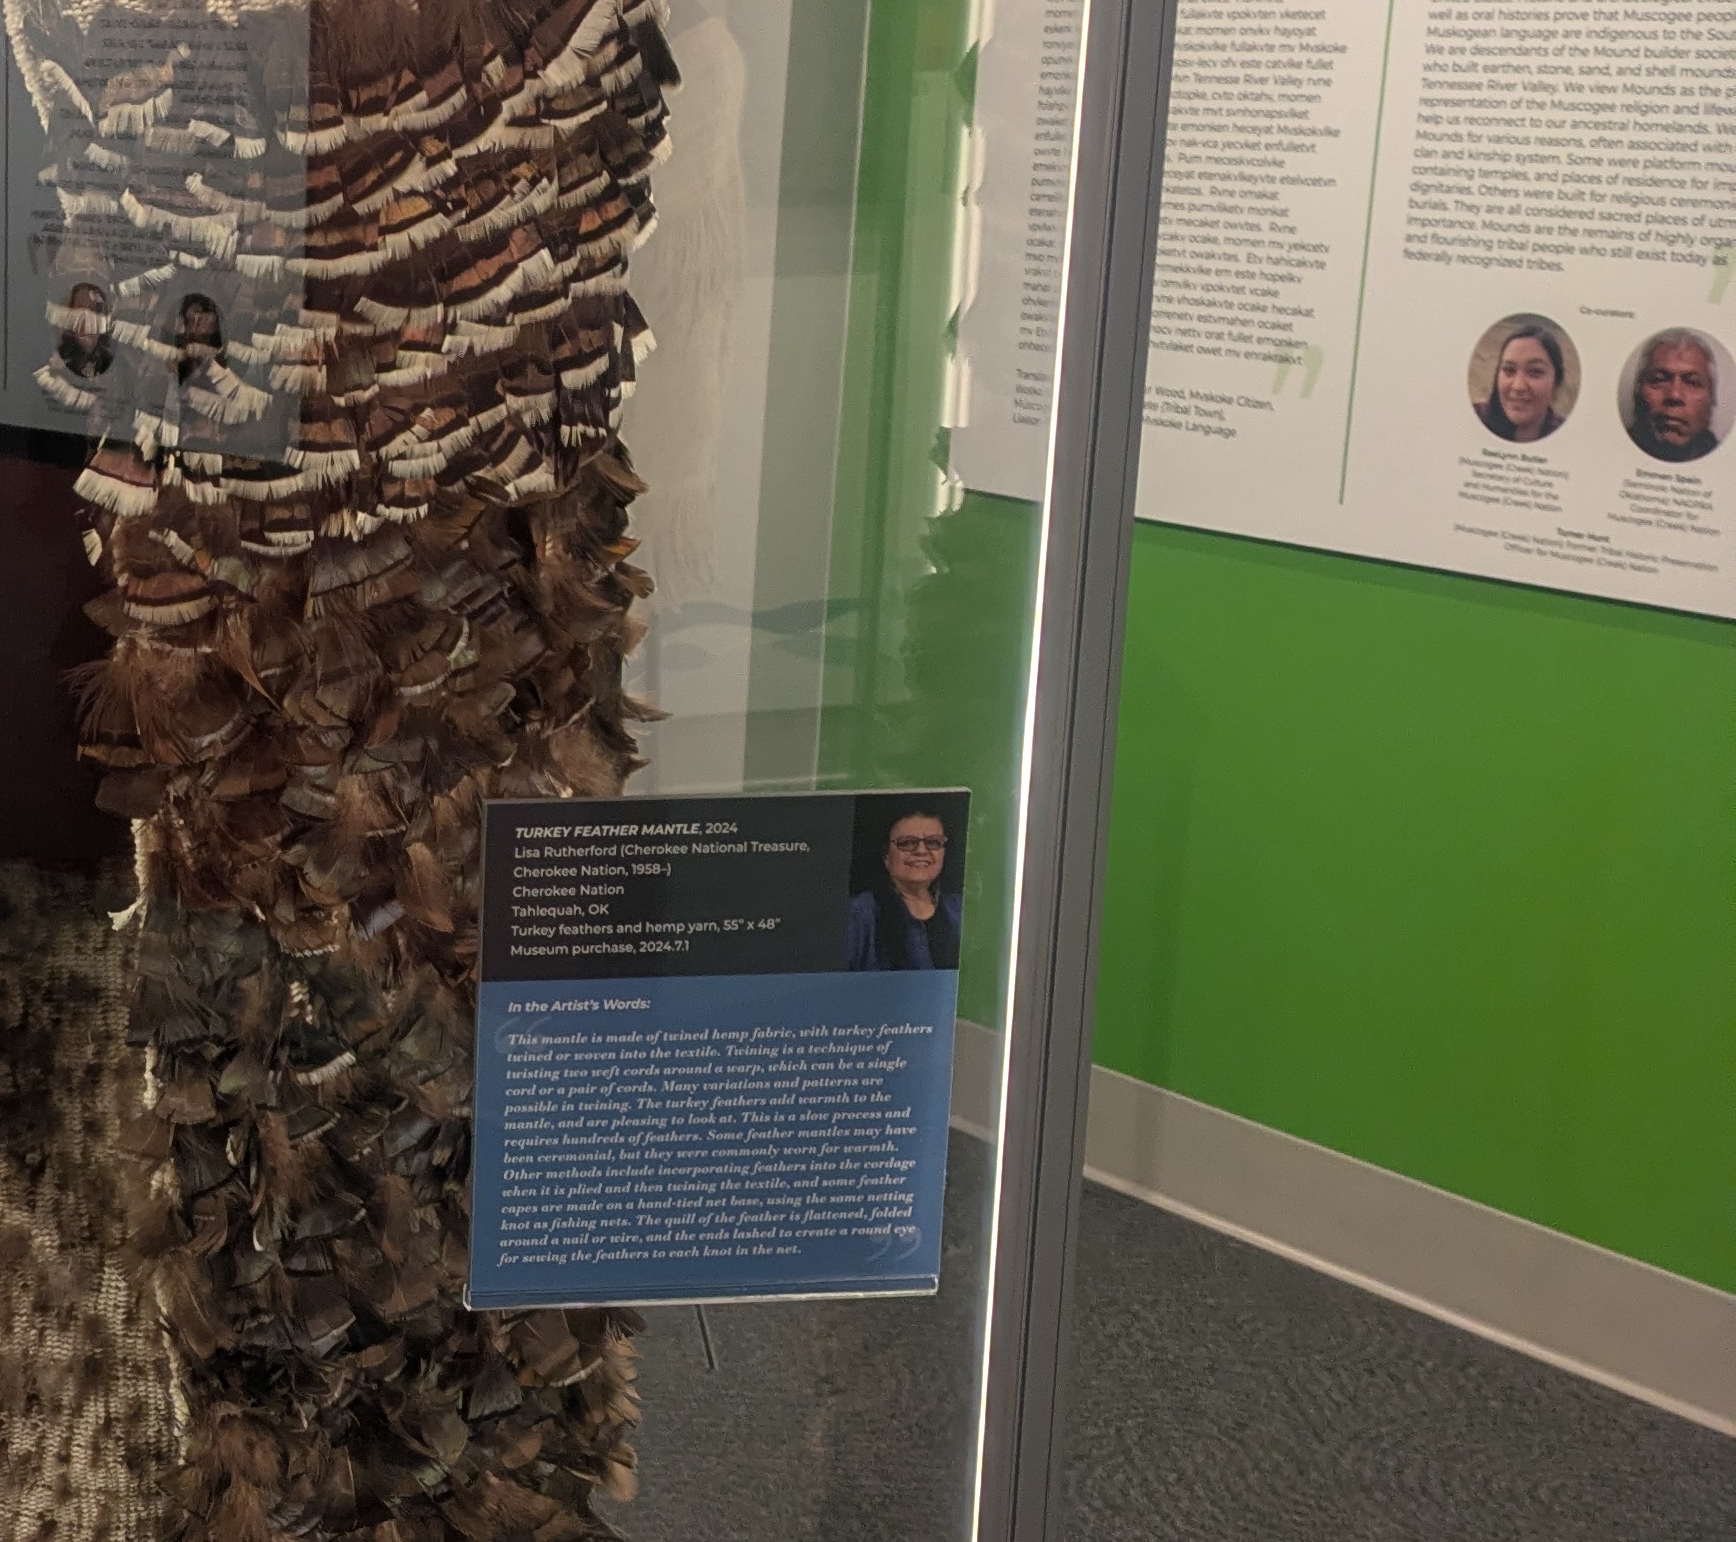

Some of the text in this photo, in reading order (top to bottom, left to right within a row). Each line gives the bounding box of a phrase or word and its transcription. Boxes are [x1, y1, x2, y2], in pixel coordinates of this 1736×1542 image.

[516, 822, 737, 839] TURKEY FEATHER MANTLE, 2024
[514, 838, 810, 858] Lisa Rutherford (Cherokee National Treasure,
[513, 865, 577, 878] Cherokee
[580, 864, 628, 878] Nation,
[512, 884, 624, 897] Cherokee Nation
[511, 904, 609, 920] Tahlequah, OK
[510, 924, 556, 939] Turkey
[558, 922, 613, 935] feathers
[616, 922, 642, 933] and
[645, 921, 685, 936] hemp
[687, 922, 720, 935] yarn,
[746, 921, 754, 930] x
[510, 940, 689, 957] Museum purchase, 2024.7.1
[508, 1001, 522, 1013] In
[525, 1001, 548, 1012] the
[603, 998, 650, 1010] Words:
[508, 1023, 932, 1044] This mantle is made of twined hemp fabric, with turkey feathers
[507, 1051, 553, 1061] twined
[619, 1049, 646, 1058] into
[650, 1048, 671, 1057] the
[674, 1047, 720, 1057] textile.
[726, 1045, 779, 1059] Twining
[782, 1045, 794, 1054] is
[808, 1043, 873, 1056] technique
[876, 1042, 892, 1055] of
[506, 1068, 560, 1081] twisting
[563, 1067, 588, 1076] two
[591, 1066, 620, 1079] weft
[623, 1065, 660, 1075] cords
[663, 1064, 712, 1074] around
[726, 1065, 764, 1075] warp,
[768, 1061, 807, 1071] which
[838, 1060, 853, 1069] be
[867, 1058, 907, 1071] single
[505, 1085, 537, 1095] cord
[567, 1083, 597, 1096] pair
[599, 1083, 616, 1095] of
[616, 1082, 657, 1092] cords.
[661, 1081, 699, 1094] Many
[703, 1079, 770, 1090] variations
[773, 1078, 800, 1088] and
[801, 1076, 858, 1090] patterns
[503, 1092, 891, 1114] possible in twining. The turkey feathers add warmth to the
[504, 1118, 555, 1130] mantle,
[557, 1117, 584, 1127] and
[610, 1115, 668, 1128] pleasing
[671, 1114, 685, 1123] to
[687, 1113, 716, 1123] look
[718, 1113, 736, 1122] at.
[741, 1112, 770, 1122] This
[773, 1111, 785, 1121] is
[799, 1110, 829, 1120] slow
[831, 1111, 882, 1122] process
[884, 1108, 911, 1117] and
[504, 1124, 917, 1148] requires hundreds of feathers. Some feather mantles may have
